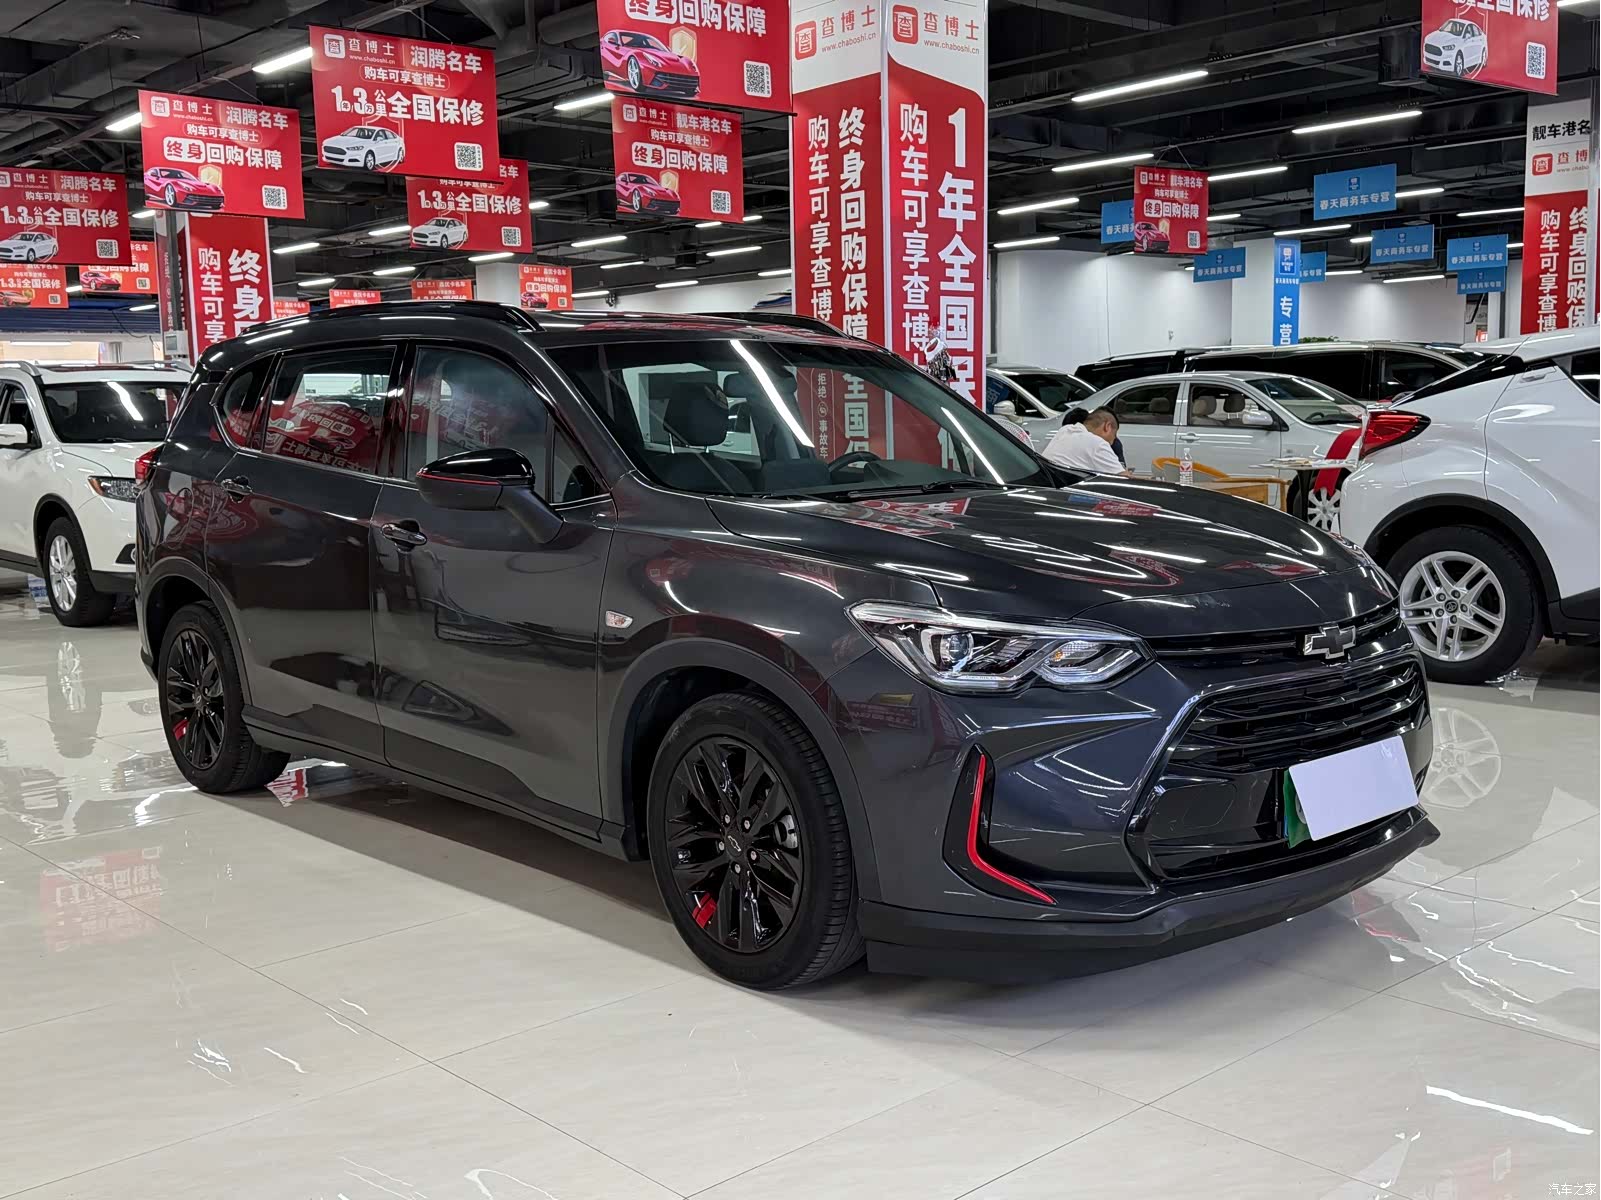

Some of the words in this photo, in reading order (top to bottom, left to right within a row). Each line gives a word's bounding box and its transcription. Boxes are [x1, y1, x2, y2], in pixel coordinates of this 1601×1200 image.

[821, 5, 876, 39] 查博士
[923, 11, 979, 41] 查博士
[348, 38, 395, 56] 查博士
[821, 32, 877, 54] www.chaboshi.cn
[923, 38, 980, 55] www.chaboshi.cn
[349, 54, 396, 65] www.chaboshi.cn
[410, 45, 483, 74] 润腾名车
[364, 66, 446, 88] 购车可享查博士
[172, 99, 213, 115] 查博士
[226, 105, 289, 130] 润腾名车
[676, 112, 733, 135] 靓车港名车
[186, 123, 259, 142] 购车可享查博士
[650, 129, 709, 147] 购车可享查博士
[166, 140, 283, 170] 终身回购保障
[634, 145, 728, 175] 终身回购保障
[60, 175, 117, 192] 润腾名车
[25, 191, 89, 203] 购车可享查博士
[1319, 191, 1390, 211] 春天商务车专营
[807, 114, 833, 322] 购车可享查博
[1145, 201, 1199, 219] 终身回购保障
[1375, 244, 1429, 257] 春天商务车专营
[1451, 252, 1503, 265] 春天商务车专营
